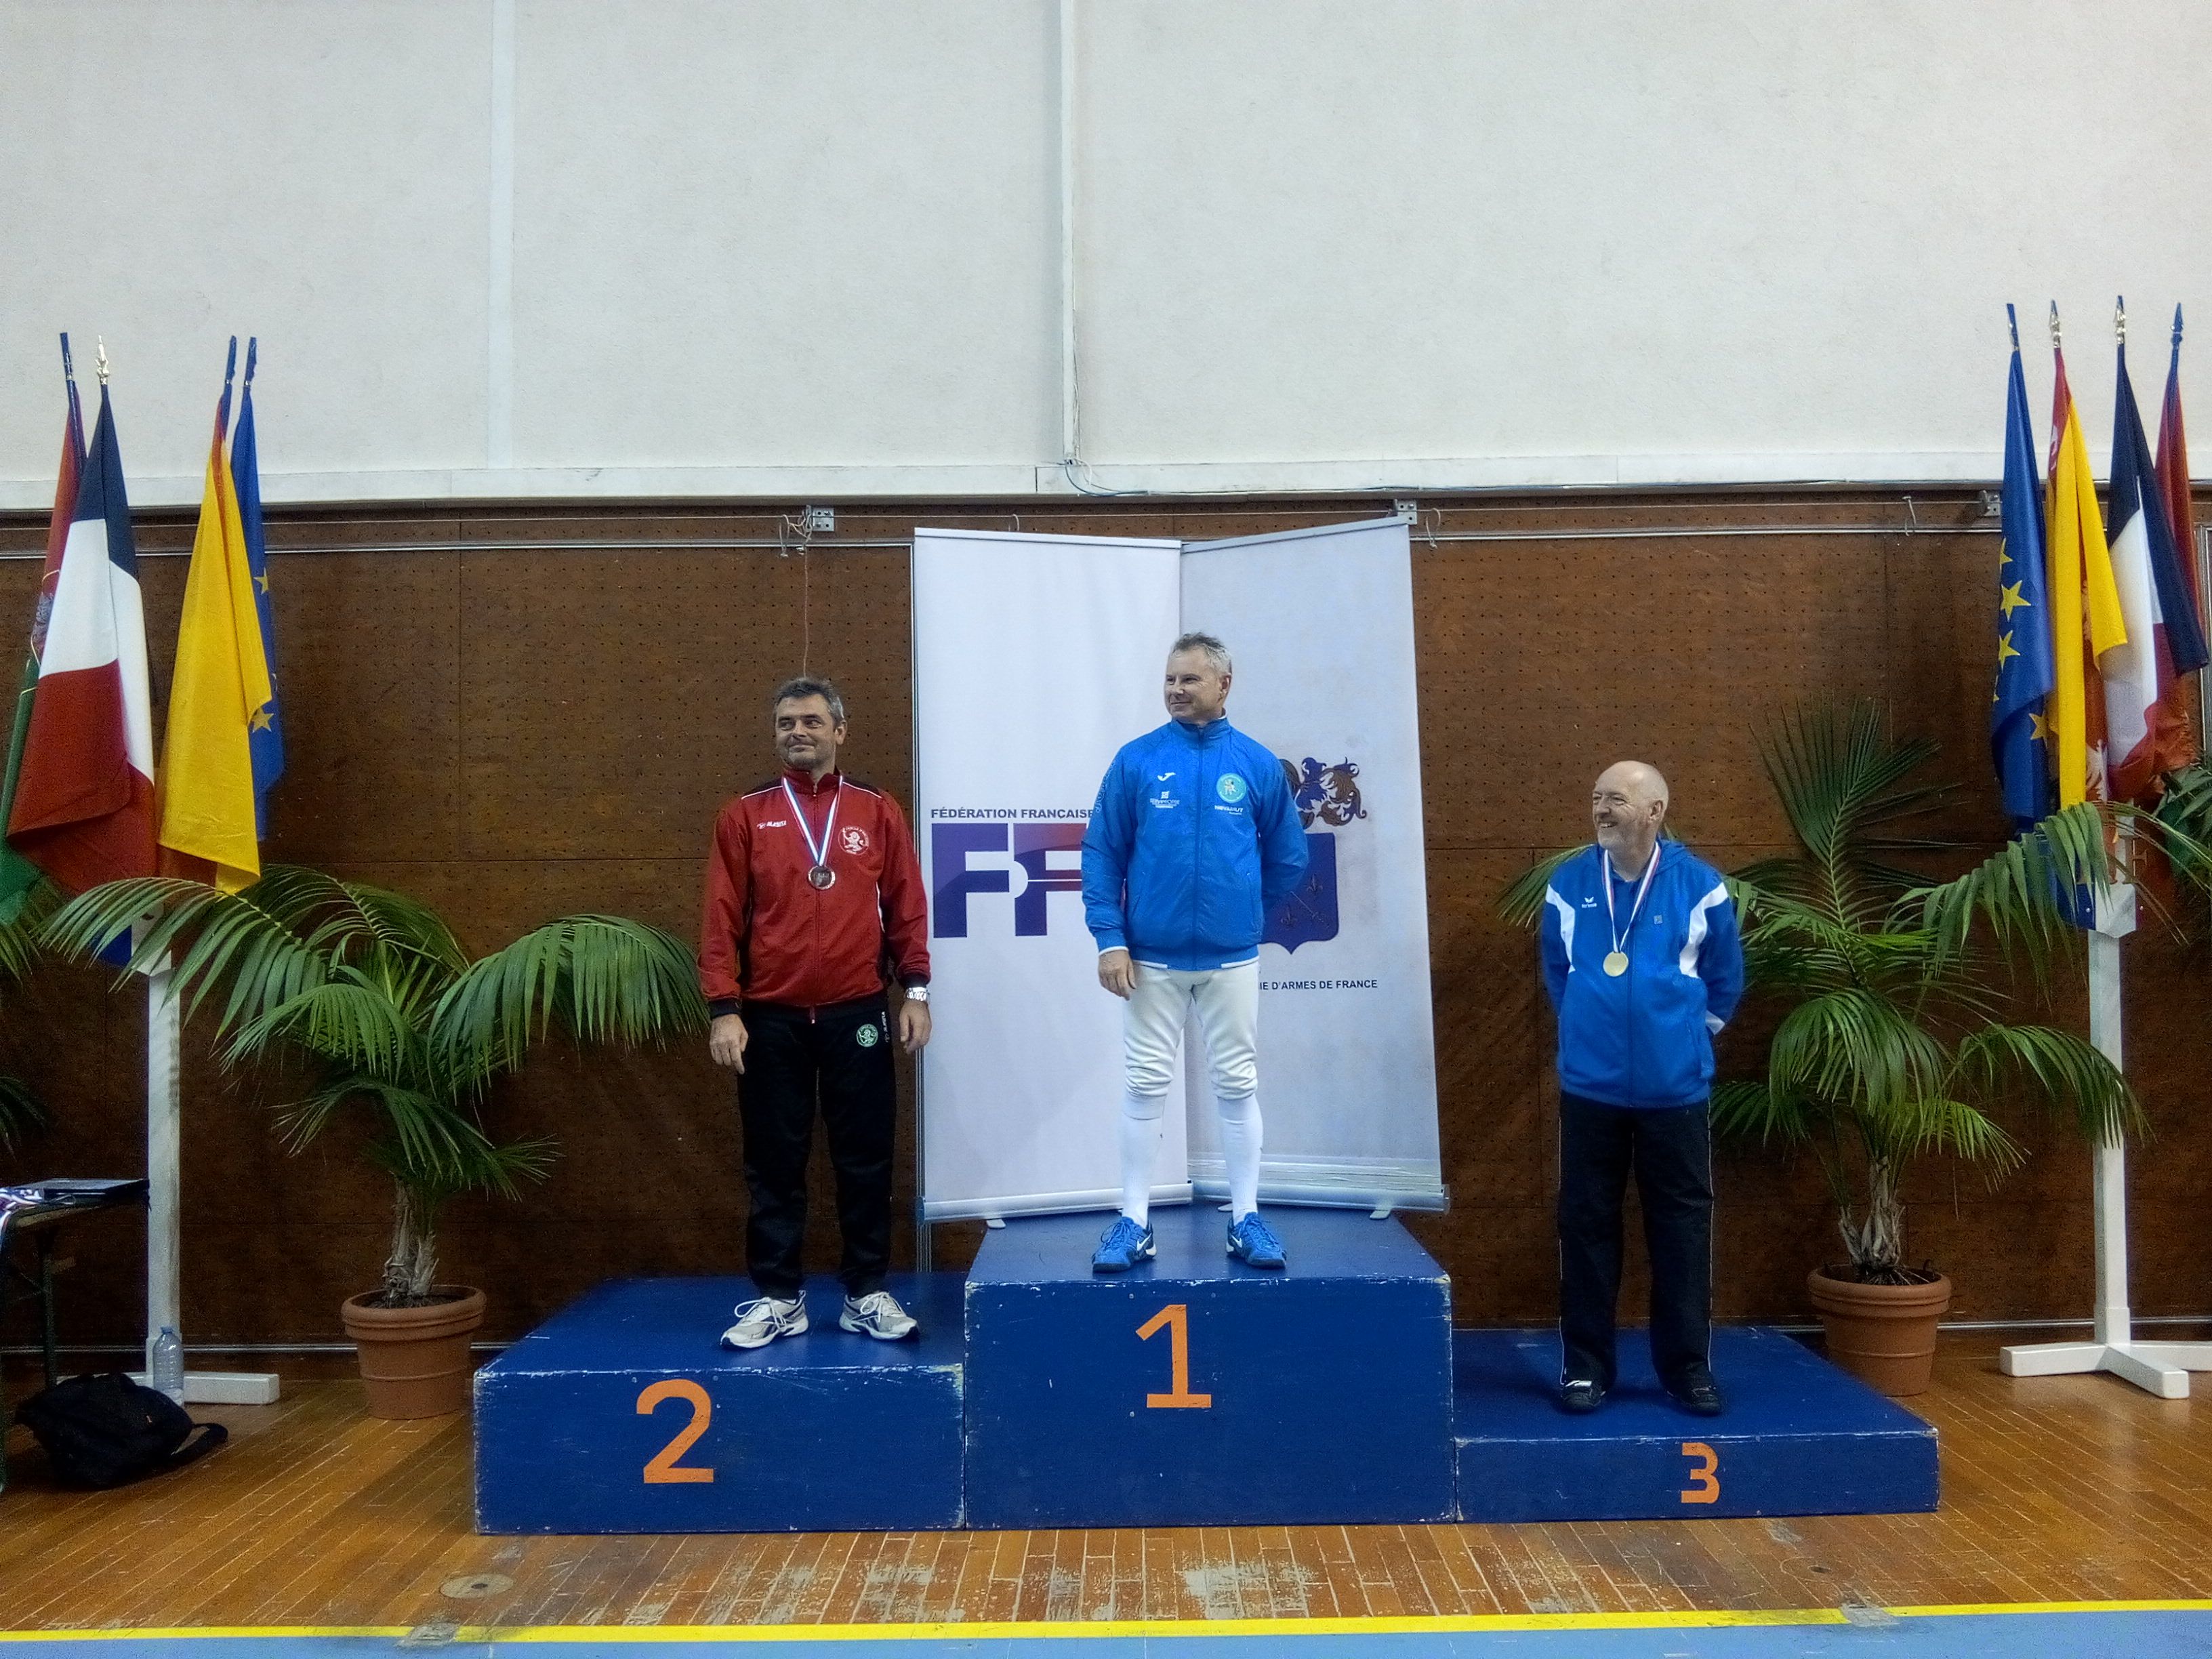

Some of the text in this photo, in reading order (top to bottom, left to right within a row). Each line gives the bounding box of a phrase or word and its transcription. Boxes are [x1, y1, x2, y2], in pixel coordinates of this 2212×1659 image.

[930, 806, 1017, 819] FÉDÉRATION
[1271, 981, 1317, 990] D'ARMES
[1319, 980, 1333, 989] DE
[1336, 979, 1378, 988] FRANCE
[1135, 1304, 1212, 1408] 1
[636, 1378, 714, 1484] 2
[1681, 1441, 1721, 1504] 3
